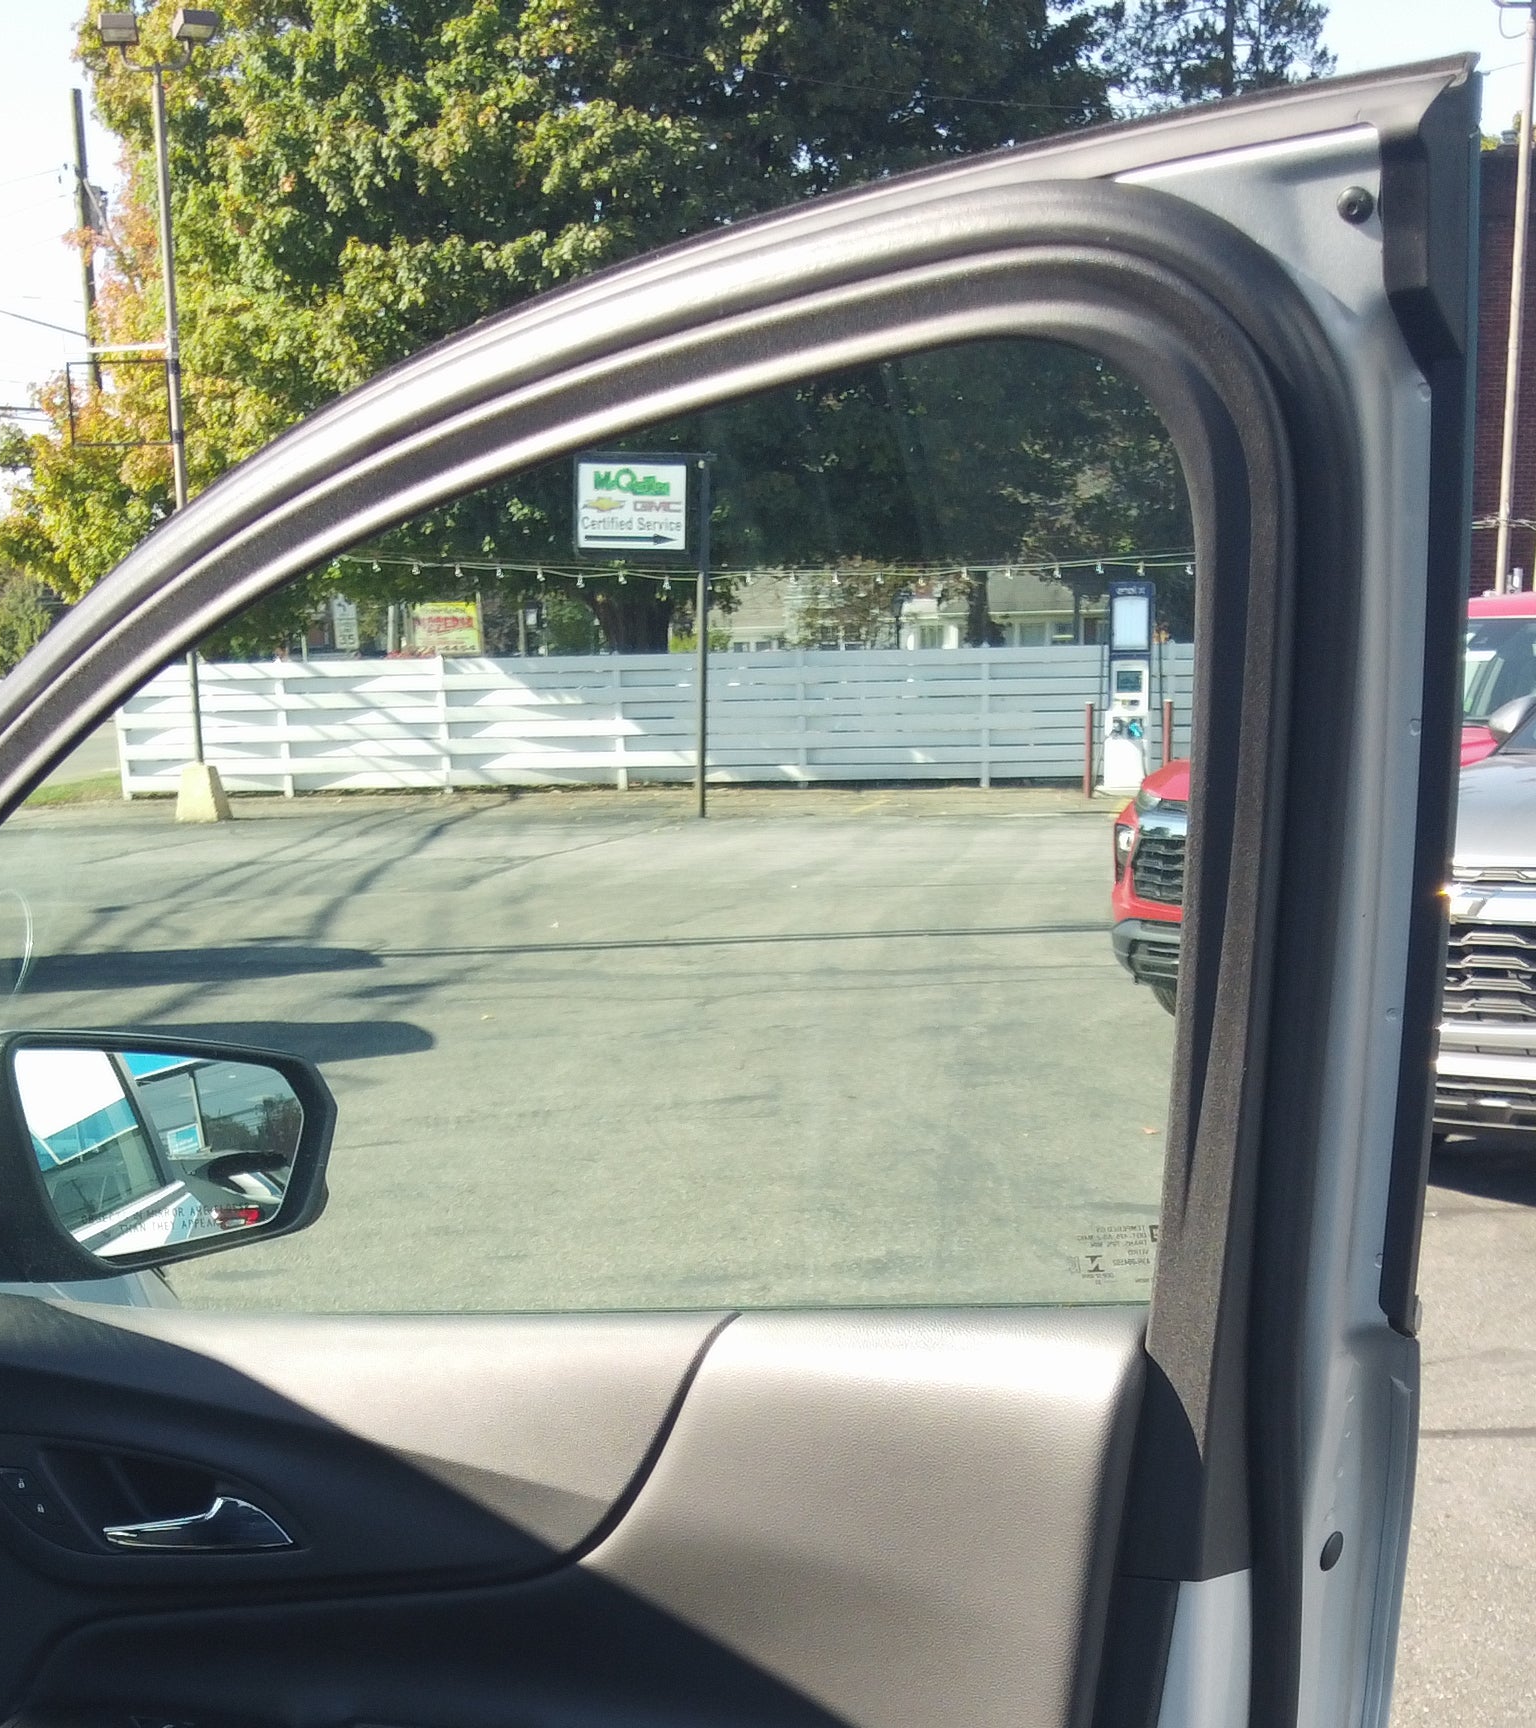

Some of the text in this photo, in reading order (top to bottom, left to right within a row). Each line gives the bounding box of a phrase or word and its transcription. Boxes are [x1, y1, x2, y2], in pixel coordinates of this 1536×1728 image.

[633, 501, 682, 513] GMC
[581, 516, 682, 532] Certified Service
